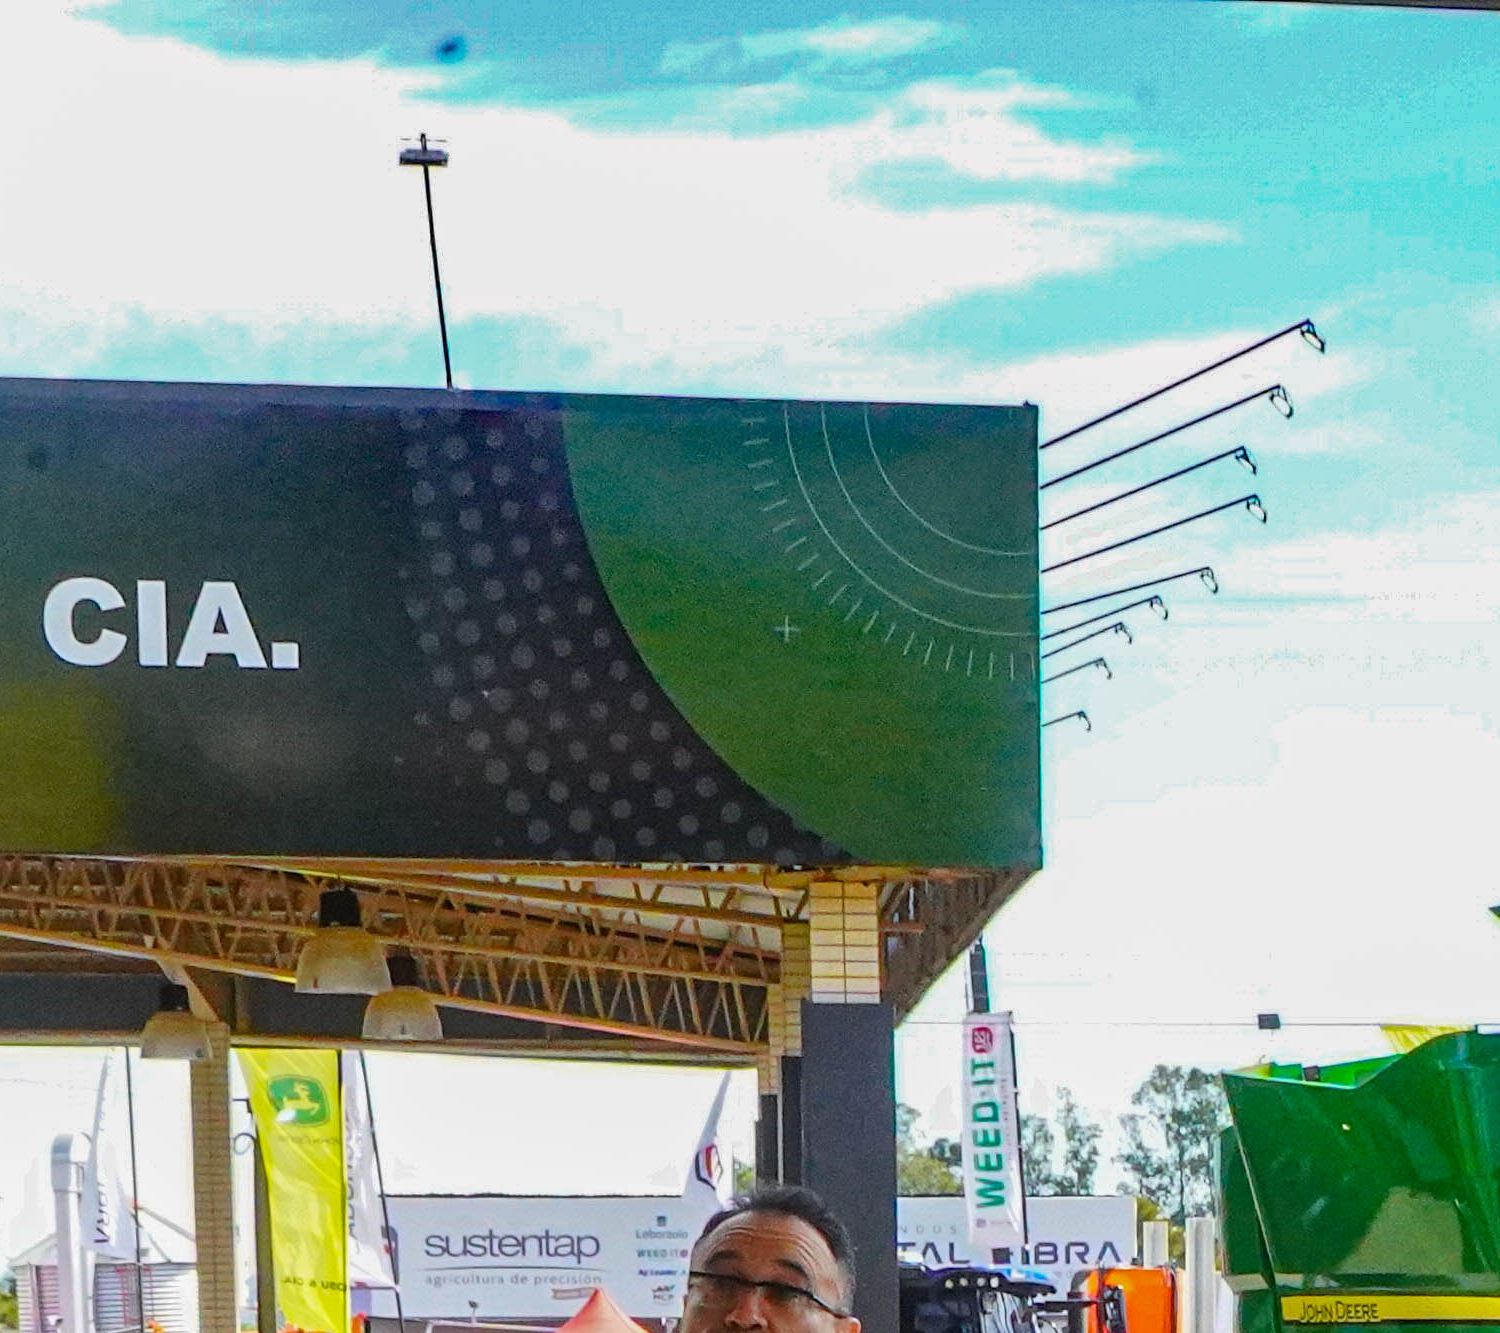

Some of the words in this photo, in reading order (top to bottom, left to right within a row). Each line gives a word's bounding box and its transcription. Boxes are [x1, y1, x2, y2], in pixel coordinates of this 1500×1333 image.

[42, 576, 300, 670] CIA.
[424, 1229, 600, 1264] sustentap
[425, 1273, 505, 1287] agricultura
[509, 1273, 528, 1285] de
[1299, 1301, 1334, 1323] JOHN
[1337, 1301, 1379, 1322] DEERE
